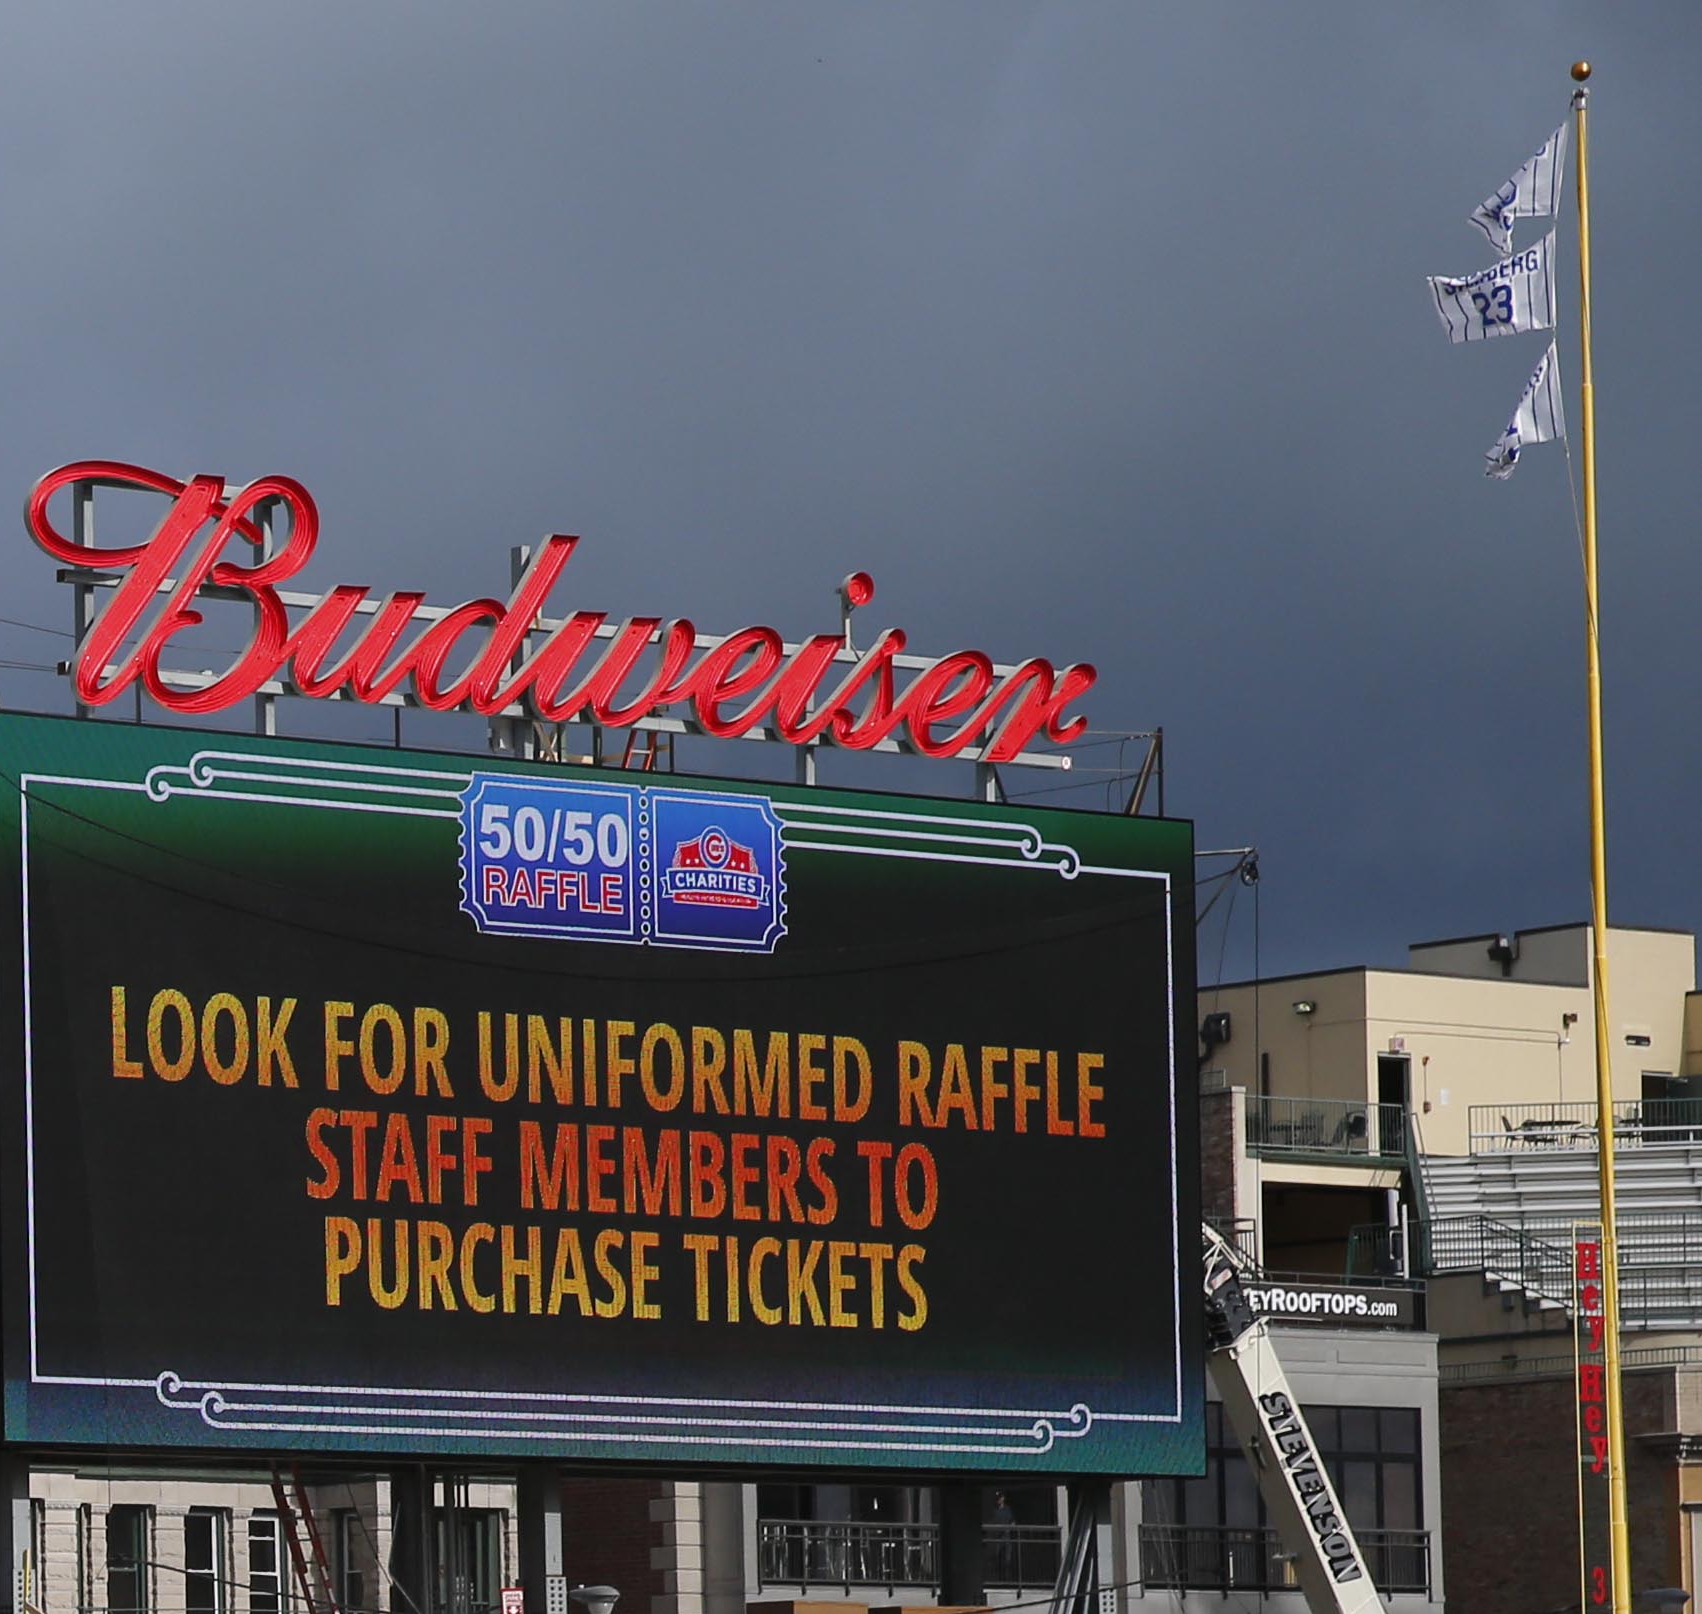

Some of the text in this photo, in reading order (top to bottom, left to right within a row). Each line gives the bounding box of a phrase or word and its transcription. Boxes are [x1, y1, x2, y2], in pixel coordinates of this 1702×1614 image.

[1472, 285, 1513, 325] 23
[24, 459, 1097, 763] Budweiser
[479, 804, 628, 867] 50/50
[484, 865, 623, 915] RAFFLE
[675, 872, 756, 894] CHARITIES
[109, 985, 1107, 1139] LOOK FOR UNIFORMED RAFFLE
[305, 1108, 938, 1231] STAFF MEMBERS TO
[324, 1217, 928, 1333] PURCHASE TICKETS
[1576, 1242, 1608, 1474] Hey Hey
[1258, 1391, 1364, 1584] STEVENSON
